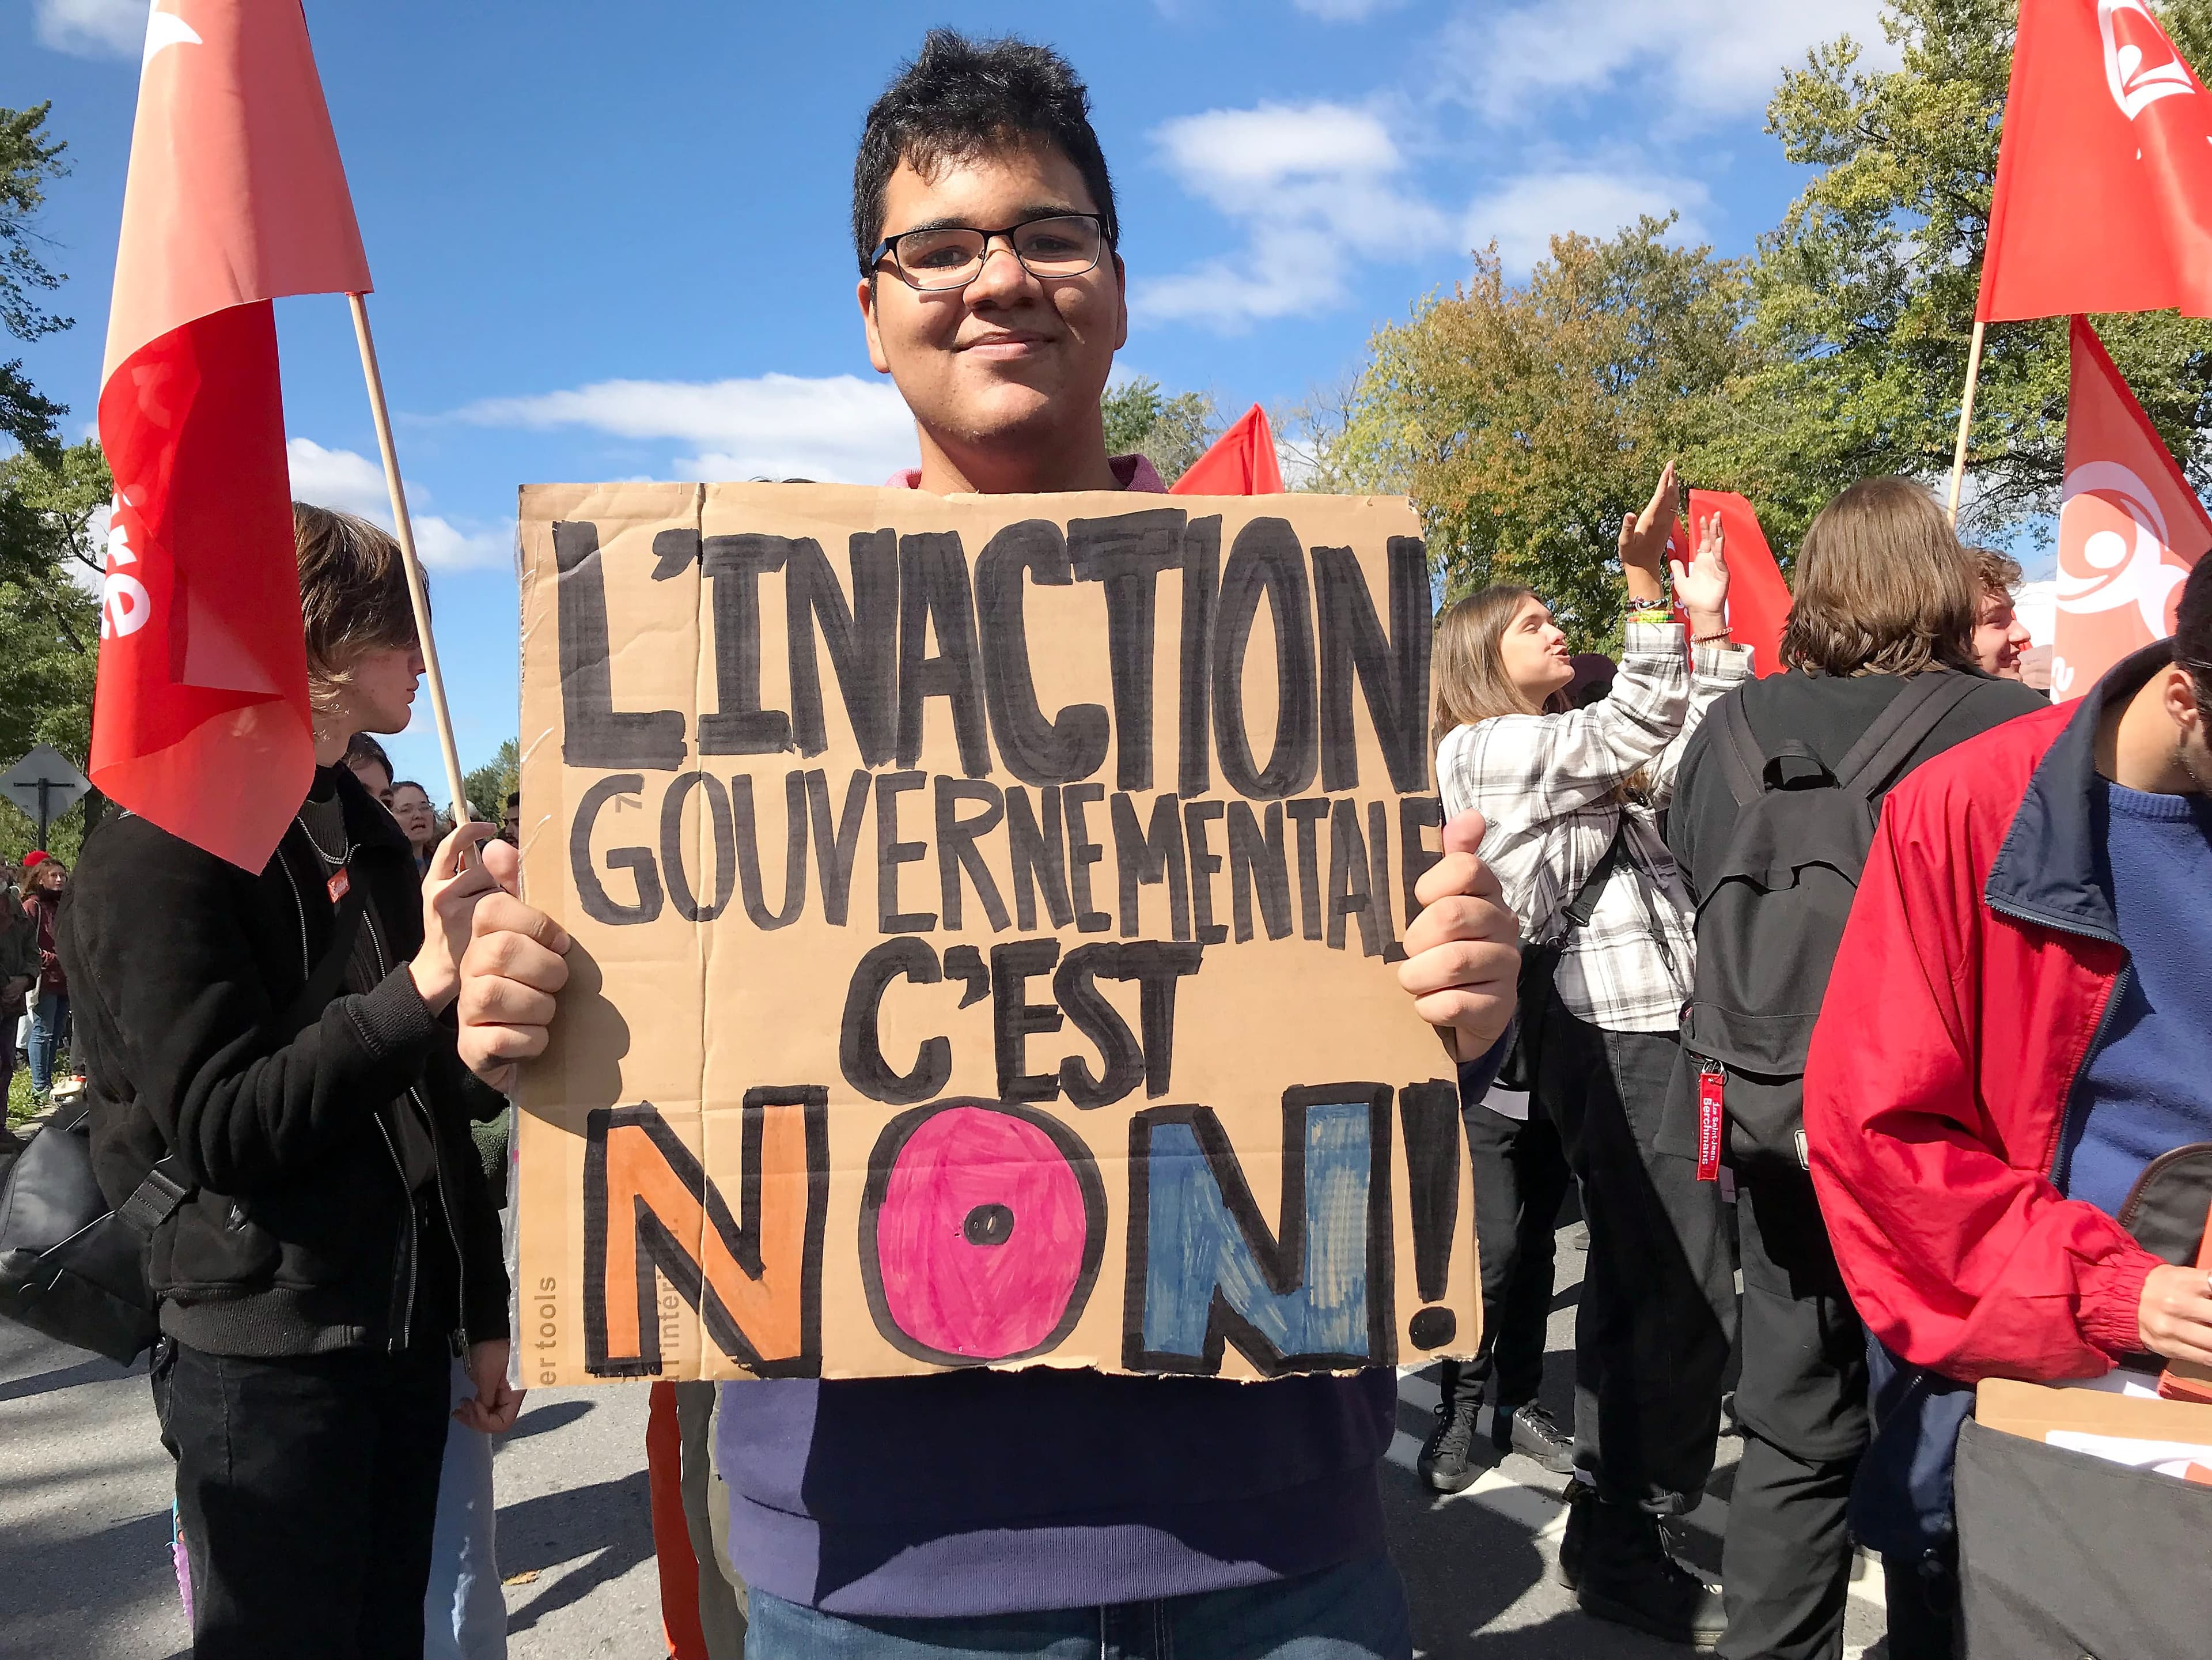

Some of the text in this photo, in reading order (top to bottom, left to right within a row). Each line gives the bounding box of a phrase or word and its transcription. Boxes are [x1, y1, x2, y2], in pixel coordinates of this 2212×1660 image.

[551, 508, 1432, 801] L'INACTION
[569, 768, 1444, 965] GOUVERNEMENTALE
[839, 936, 1205, 1110] C'EST
[1702, 1097, 1713, 1165] Berchmans
[534, 1276, 556, 1349] tools
[583, 1076, 1460, 1379] NON!
